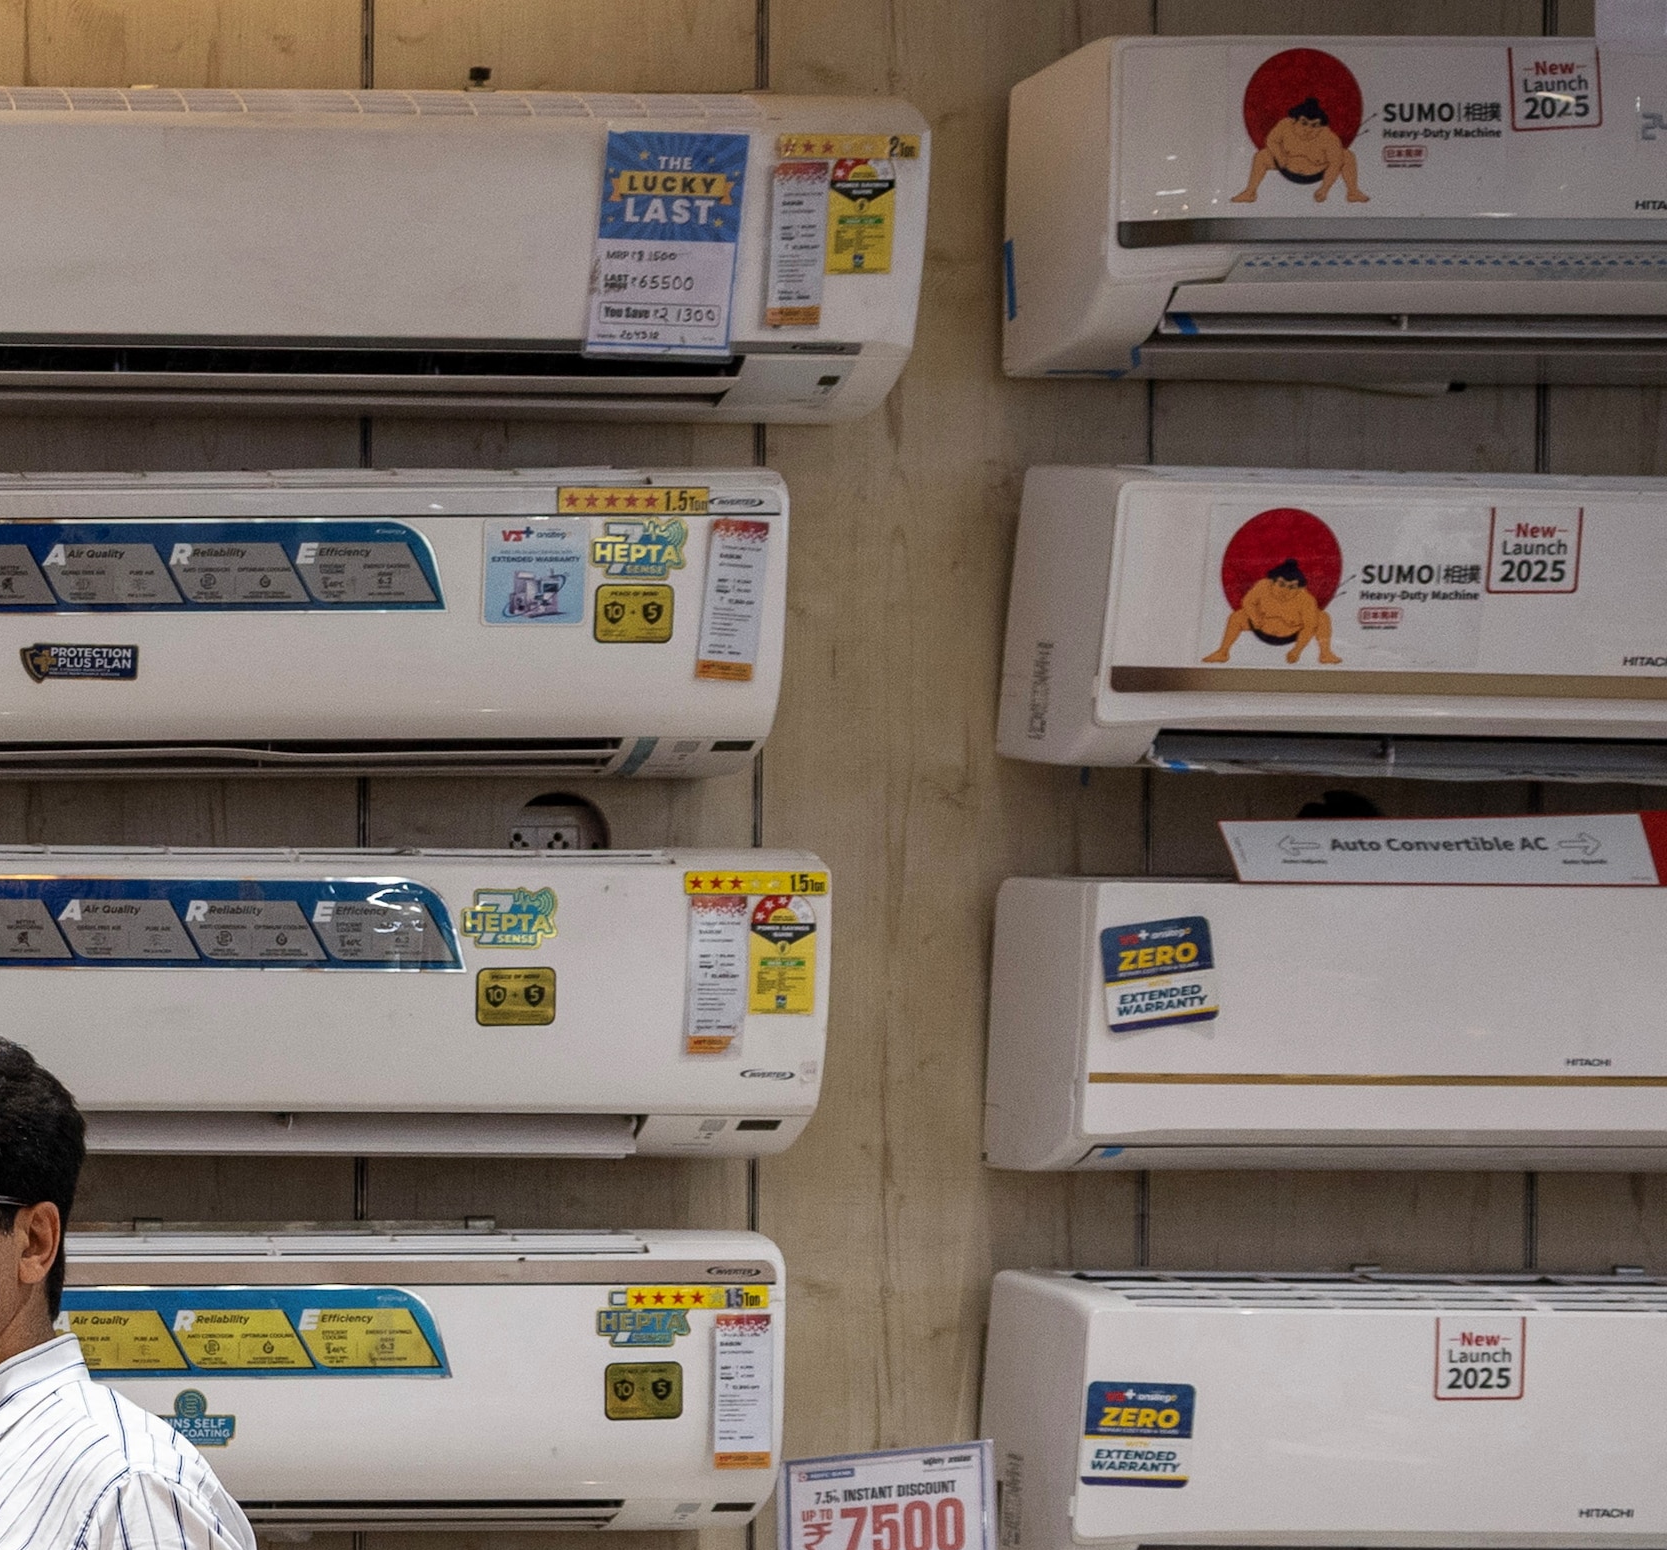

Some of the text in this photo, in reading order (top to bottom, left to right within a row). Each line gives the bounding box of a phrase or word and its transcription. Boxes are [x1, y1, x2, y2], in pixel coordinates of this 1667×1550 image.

[1383, 103, 1454, 122] SUMO
[1383, 127, 1501, 139] Heavy-Duty Machine
[658, 157, 691, 170] THE
[628, 175, 717, 193] LUCKY
[625, 198, 715, 224] LAST
[1516, 523, 1556, 538] New
[193, 548, 246, 559] Reliability
[595, 545, 678, 562] HEPTA
[1503, 540, 1567, 555] Launch
[1362, 565, 1433, 584] SUMO
[1499, 559, 1565, 582] 2025
[50, 648, 132, 659] PROTECTION
[58, 657, 132, 669] PLUS PLAN
[1331, 837, 1548, 852] Auto Convertible AC
[1118, 944, 1198, 972] ZERO
[1461, 1333, 1500, 1346] New
[1448, 1349, 1511, 1364] Launch
[1447, 1368, 1511, 1389] 2025
[843, 1487, 893, 1502] INSTANT
[897, 1481, 956, 1496] DISCOUNT
[803, 1508, 832, 1522] UP TO
[1580, 1509, 1634, 1517] HITACHI
